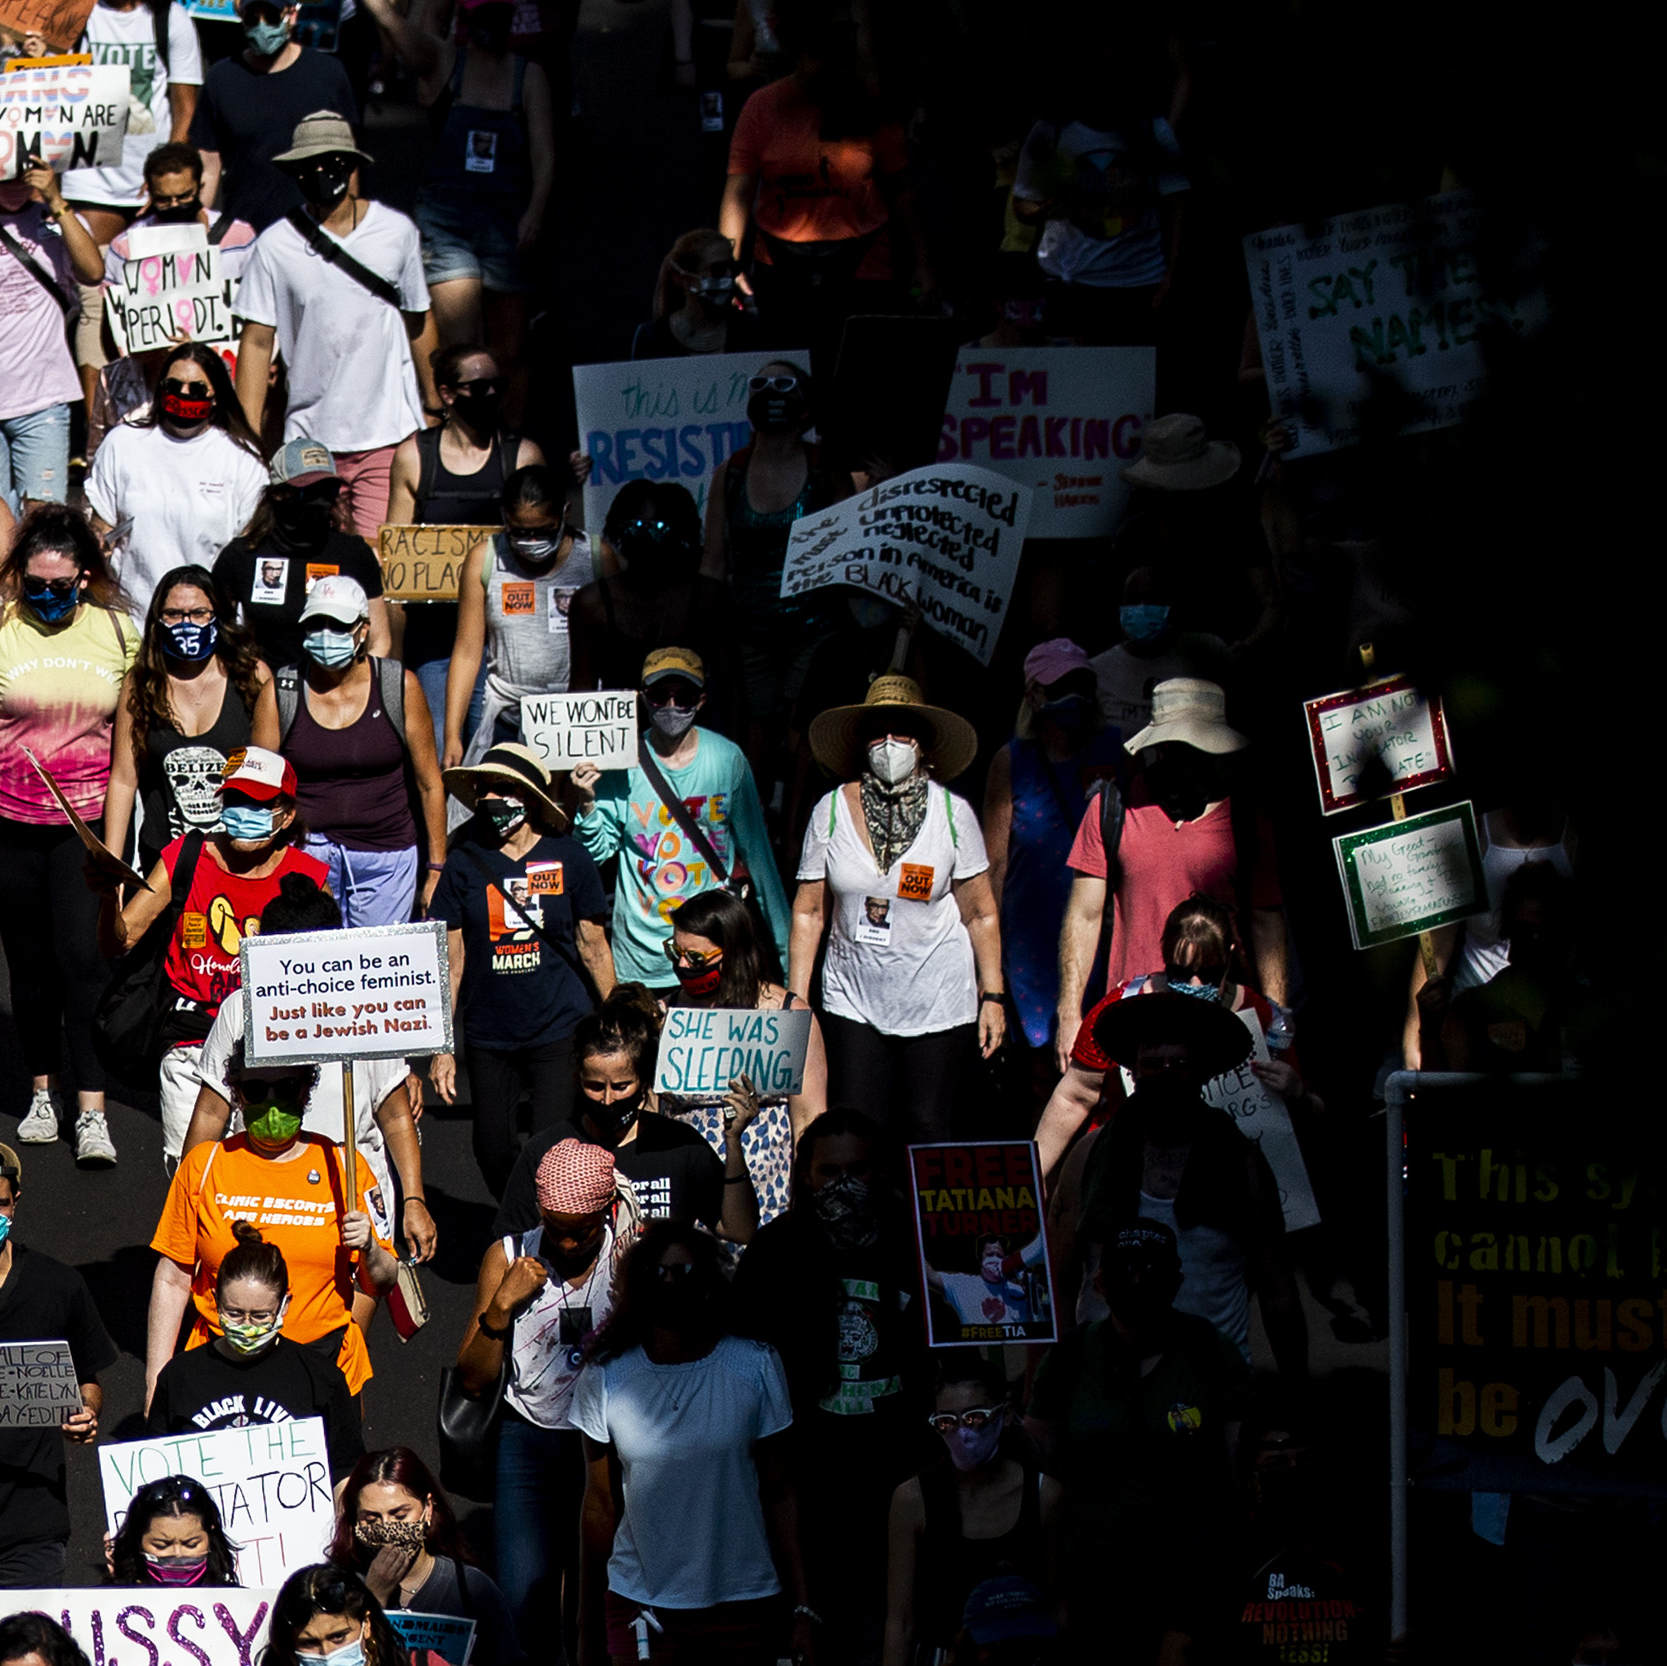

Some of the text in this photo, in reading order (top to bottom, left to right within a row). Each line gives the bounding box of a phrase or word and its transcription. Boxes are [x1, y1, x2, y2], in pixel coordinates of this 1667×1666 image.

[527, 701, 563, 725] WE
[617, 700, 635, 719] BE
[534, 728, 629, 759] SILENT
[164, 759, 227, 775] BELIZE
[280, 954, 409, 975] You can be an
[492, 952, 541, 970] MARCH
[256, 970, 436, 997] anti-choice feminist.
[269, 999, 426, 1021] Just like you can
[266, 1015, 432, 1041] be a Jewish Nazi.
[666, 1010, 780, 1045] SHE WAS
[916, 1145, 1034, 1189] FREE
[918, 1184, 1037, 1213] TATIANA
[921, 1211, 1039, 1237] TURNER
